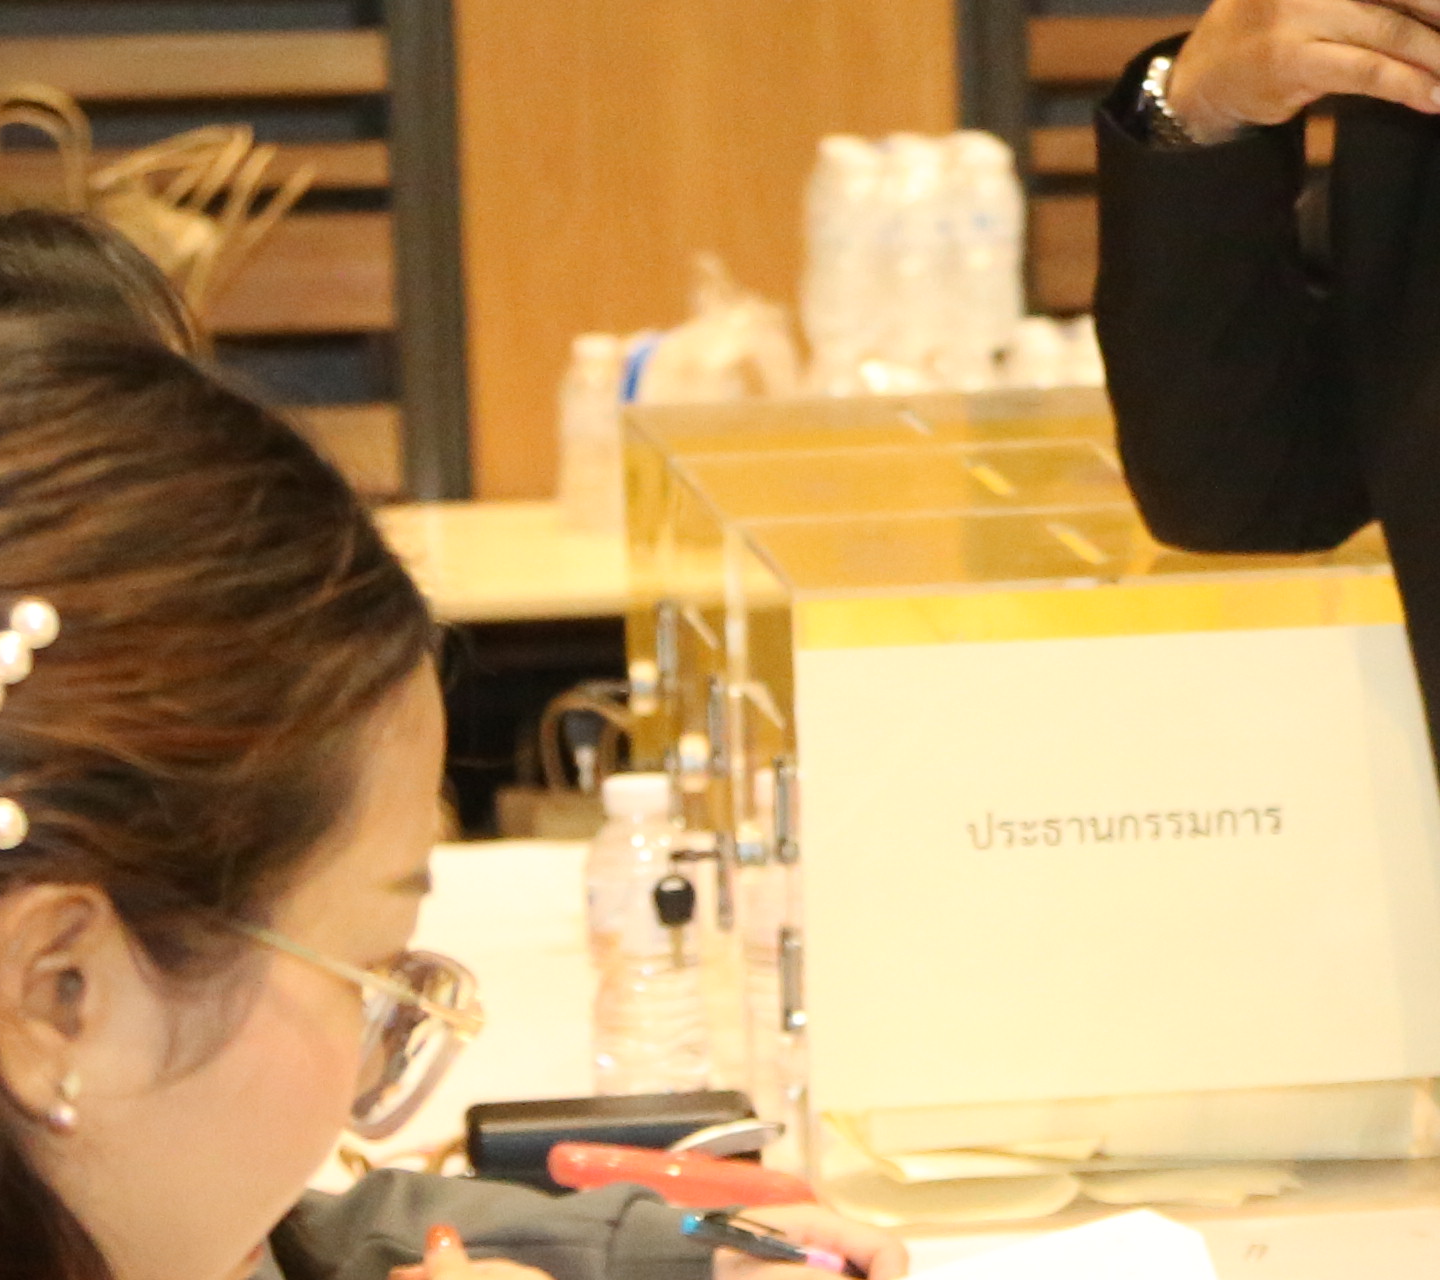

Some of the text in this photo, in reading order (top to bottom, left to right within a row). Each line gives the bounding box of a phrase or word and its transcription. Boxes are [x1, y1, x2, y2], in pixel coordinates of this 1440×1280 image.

[966, 806, 1282, 851] ประธานกรรมการ
